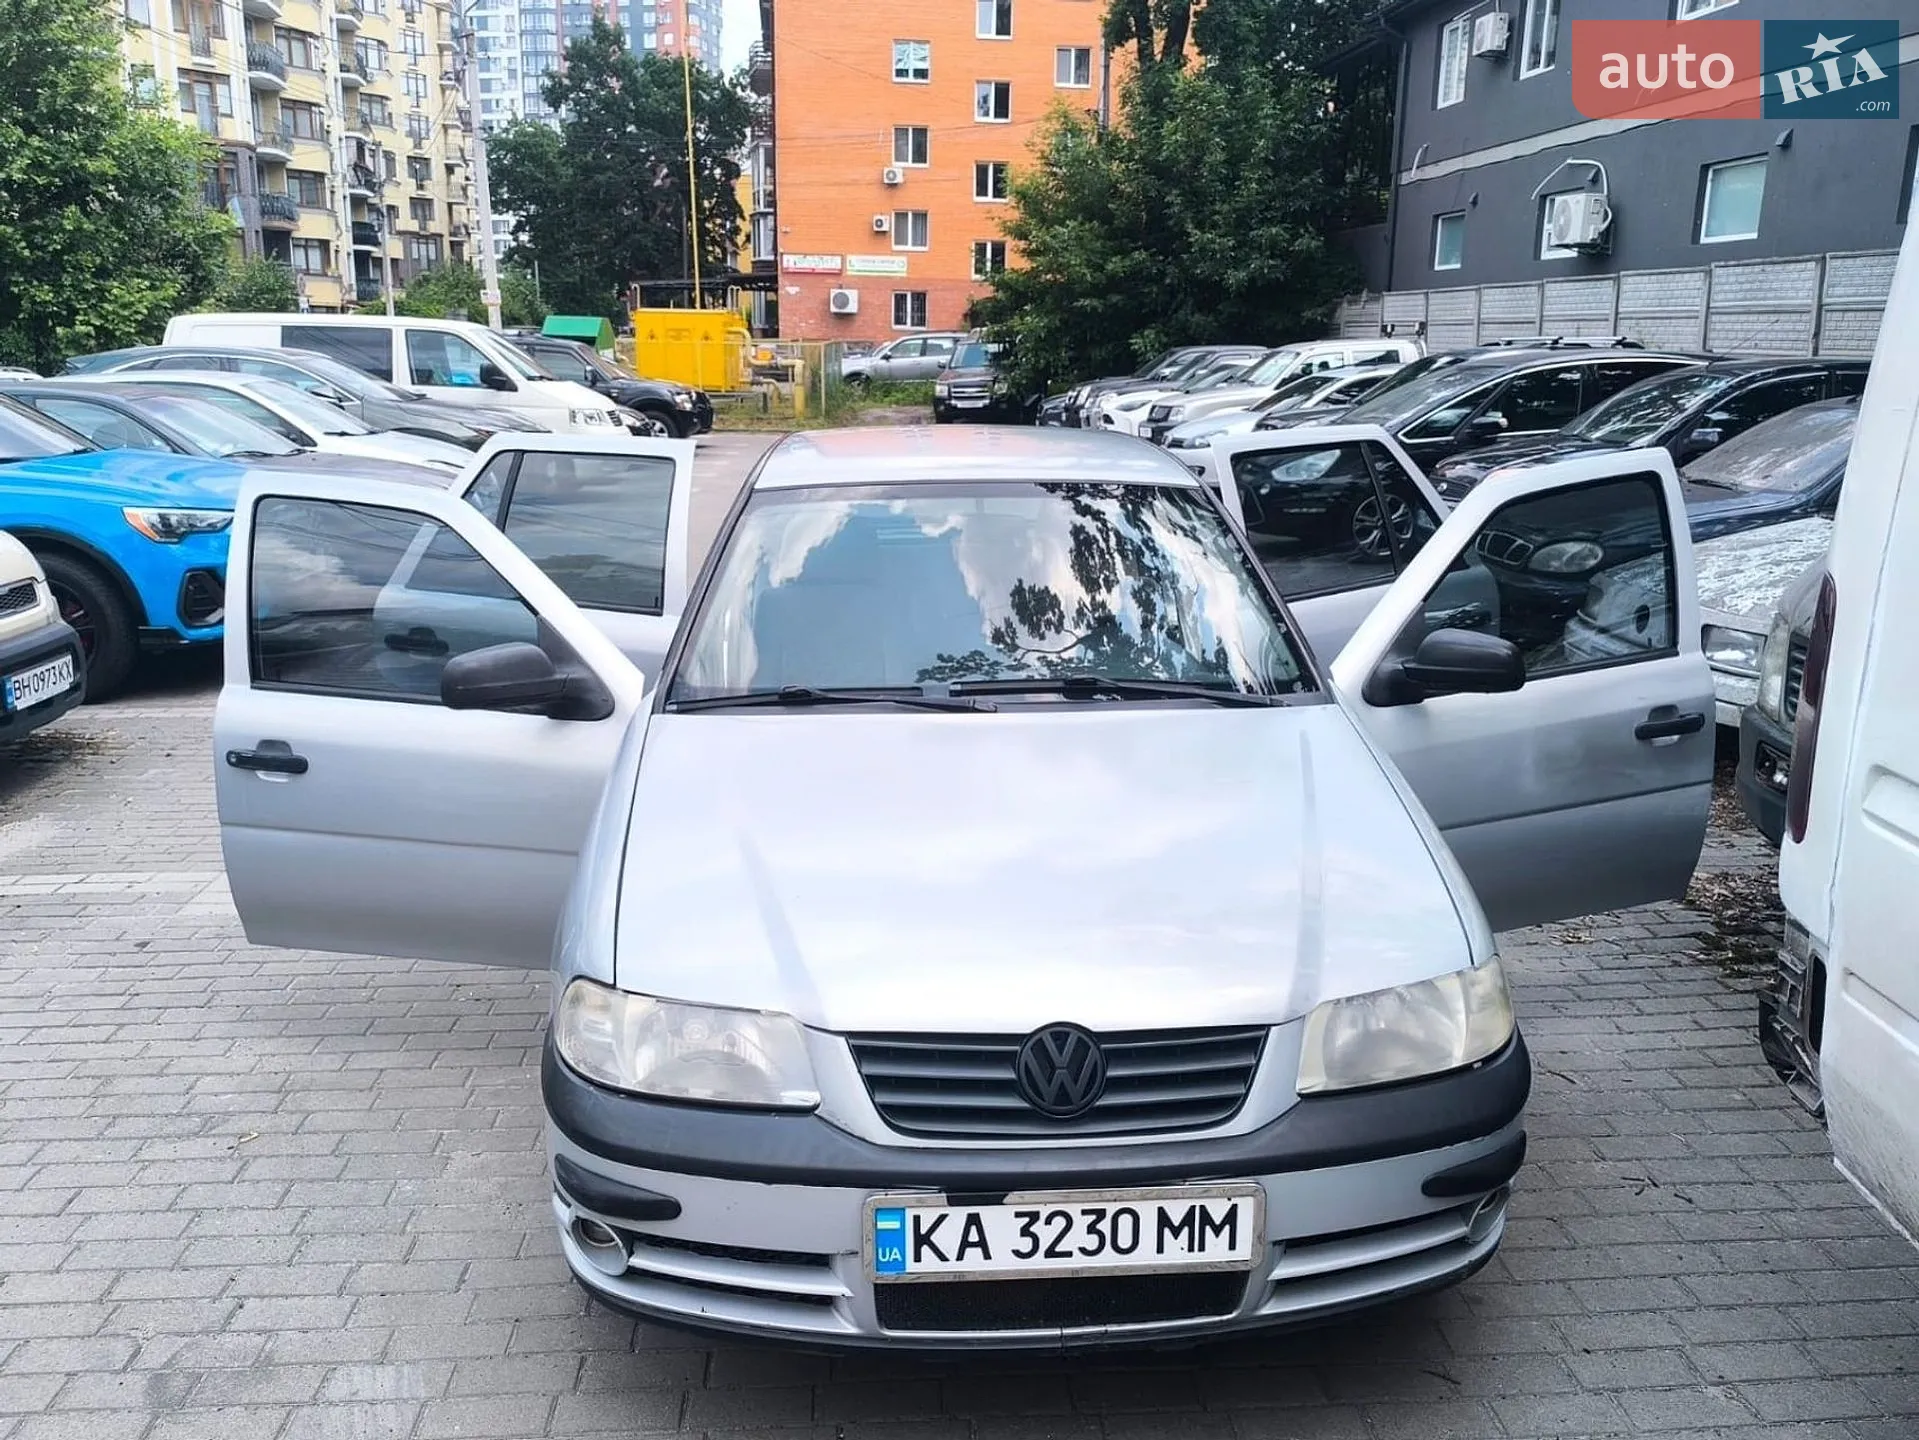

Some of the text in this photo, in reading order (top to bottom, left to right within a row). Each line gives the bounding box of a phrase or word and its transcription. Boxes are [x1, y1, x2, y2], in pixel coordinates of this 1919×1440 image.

[912, 1203, 1239, 1263] KA 3230 MM
[878, 1247, 903, 1263] UA
